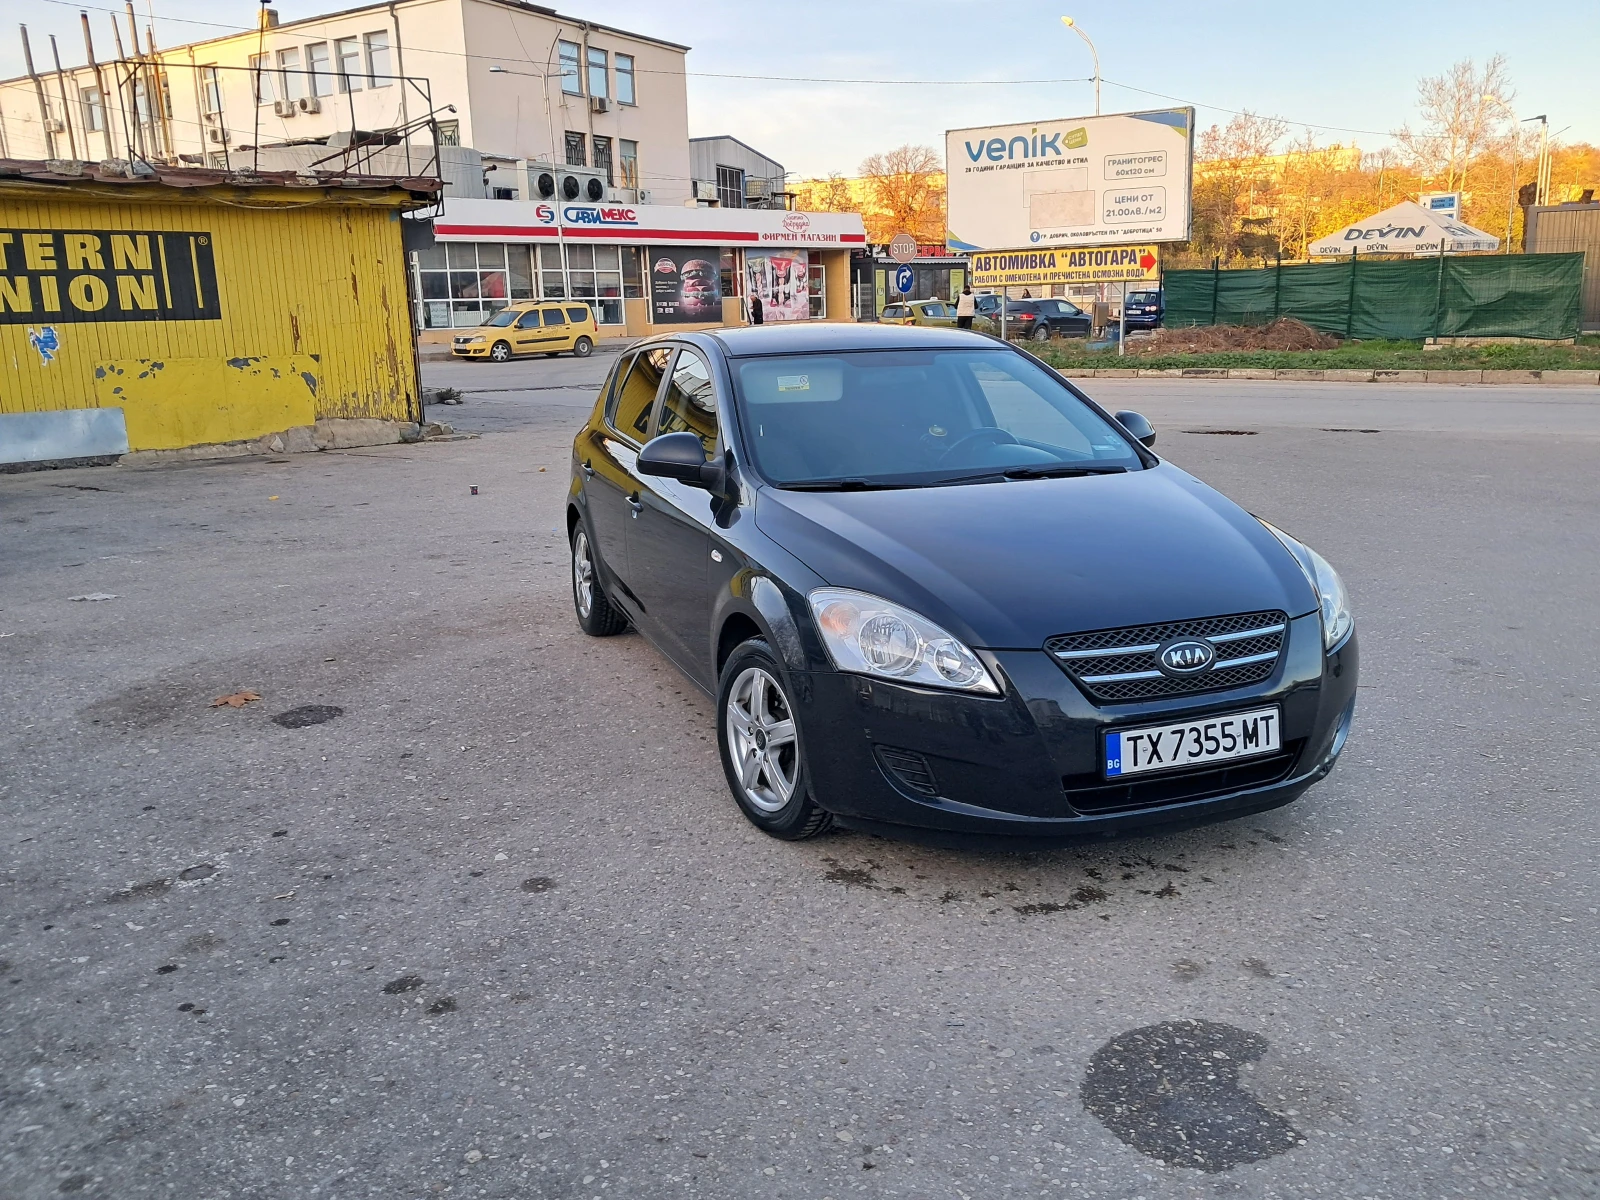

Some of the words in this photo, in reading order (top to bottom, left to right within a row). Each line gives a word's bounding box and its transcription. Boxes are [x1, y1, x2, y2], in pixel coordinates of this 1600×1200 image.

[964, 127, 1062, 162] venik
[996, 162, 1026, 170] ГАРАНЦИЯ
[1036, 159, 1065, 167] КАЧЕСТВО
[1107, 155, 1163, 166] ГРАНИТОГРЕС
[1114, 195, 1139, 204] ЦЕНИ
[1141, 194, 1154, 202] ОТ
[762, 232, 798, 241] ФИРМЕН
[800, 233, 837, 242] МАГАЗИН
[1344, 223, 1426, 241] DEVIN
[893, 243, 915, 254] STOP
[1320, 245, 1341, 254] DEVIN
[1366, 242, 1388, 251] DEVIN
[1415, 242, 1439, 251] DEVIN
[975, 253, 1056, 272] АВТОМИВКА
[974, 274, 997, 283] РАБОТИ
[999, 274, 1003, 282] С
[1005, 272, 1041, 282] ОМЕКОТЕНА
[1043, 272, 1048, 280] И
[1050, 270, 1090, 280] ПРЕЧИСТЕНА
[1092, 269, 1124, 279] ОСМОЗНА
[1126, 268, 1145, 278] ВОДА
[0, 274, 158, 312] NION
[1170, 648, 1205, 666] KIA
[1107, 759, 1120, 769] BG
